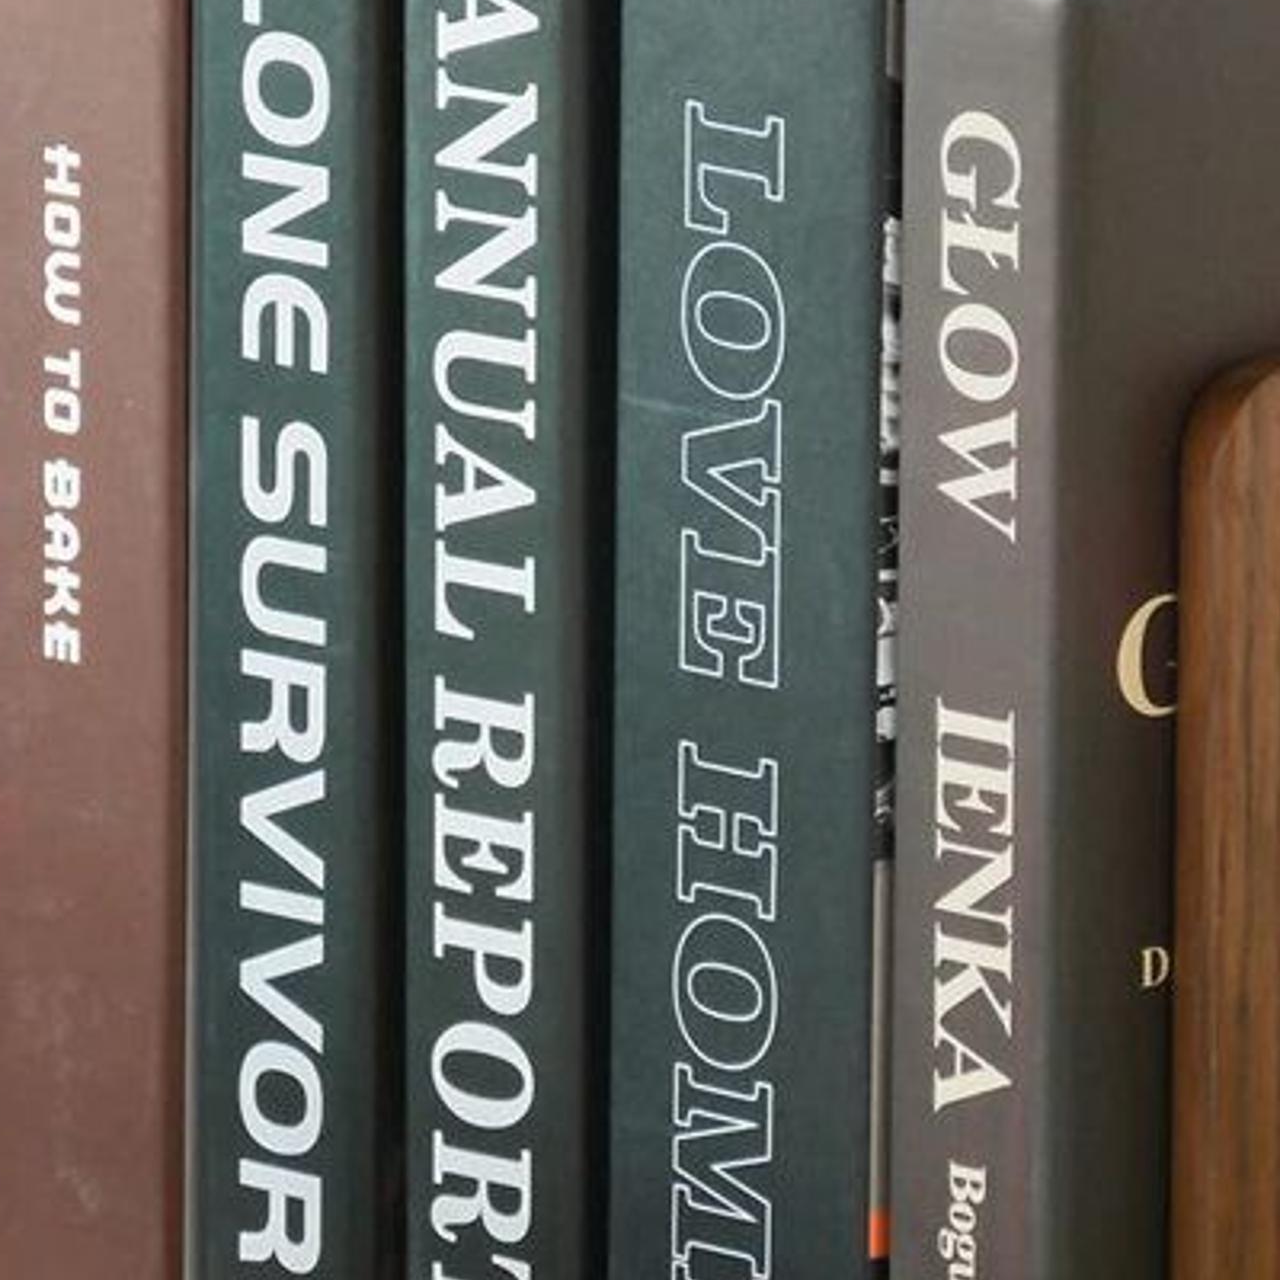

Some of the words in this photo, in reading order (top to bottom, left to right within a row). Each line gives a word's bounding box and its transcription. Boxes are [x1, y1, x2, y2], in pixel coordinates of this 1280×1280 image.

[43, 144, 81, 325] HOW
[43, 349, 81, 435] TO
[679, 98, 786, 689] LOVE
[43, 459, 81, 664] BAKE
[239, 415, 328, 1274] SURVIVOR
[933, 696, 1015, 1112] IENKA
